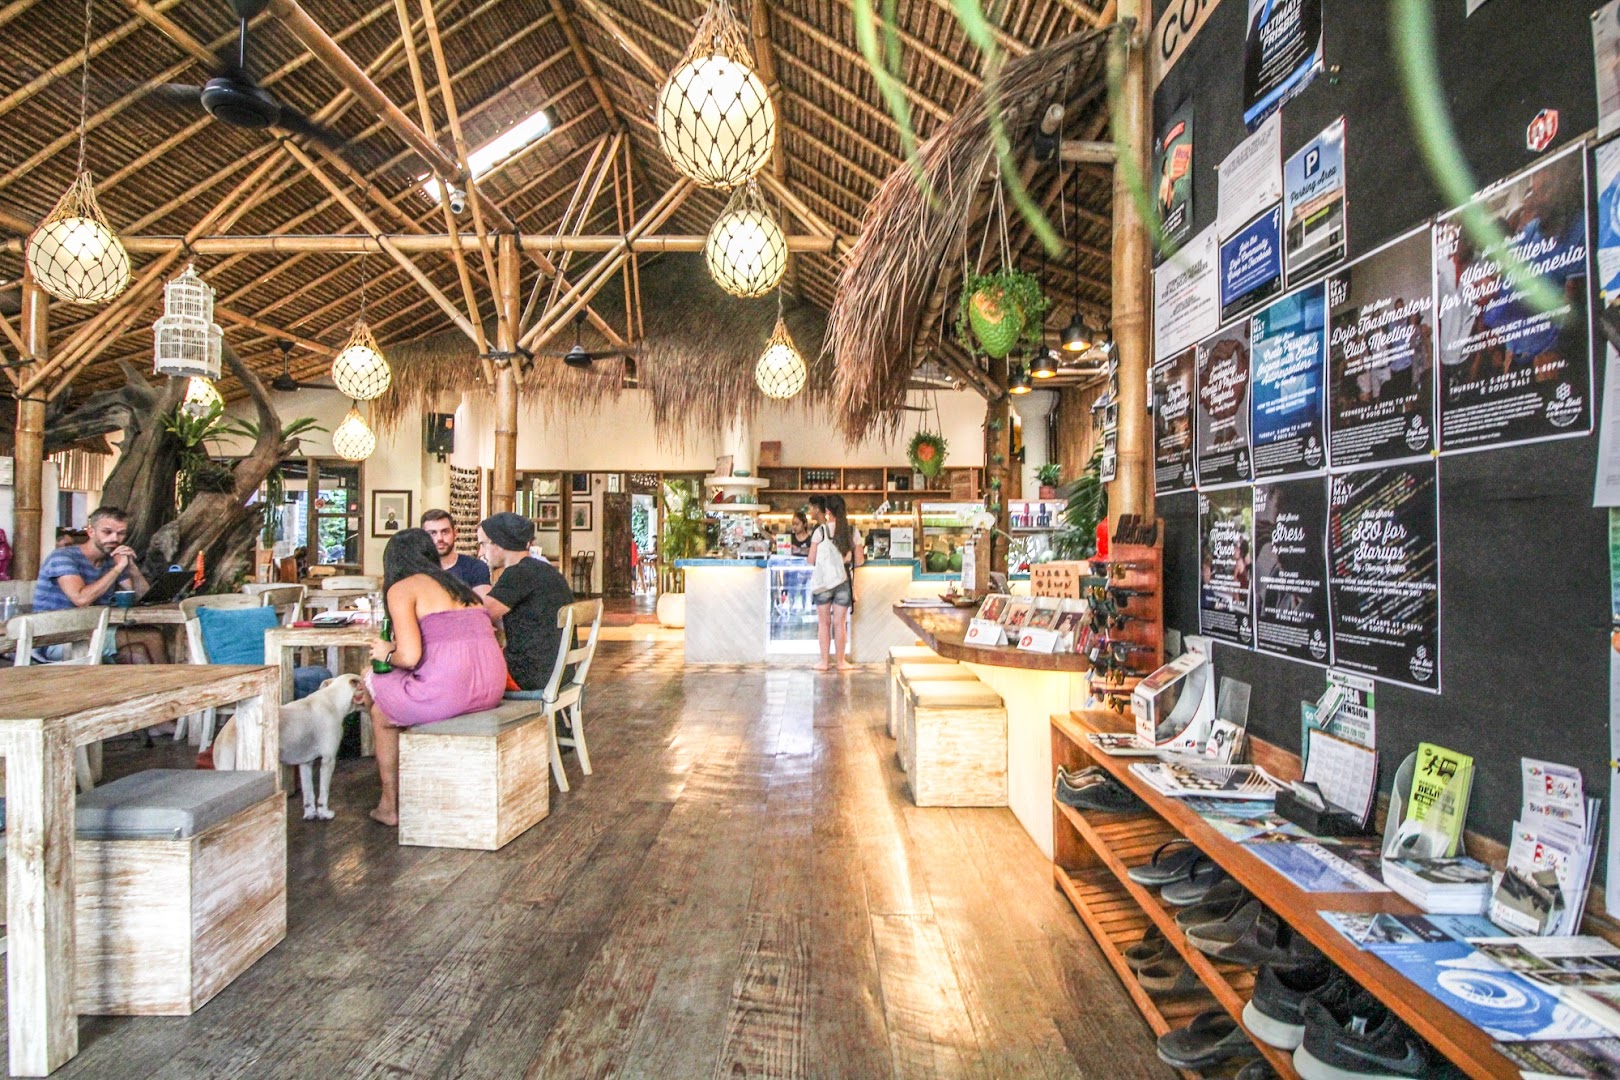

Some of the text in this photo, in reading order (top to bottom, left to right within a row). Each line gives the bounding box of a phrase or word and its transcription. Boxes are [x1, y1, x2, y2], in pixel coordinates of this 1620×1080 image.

[1262, 4, 1301, 49] FRISBEE
[1305, 151, 1318, 175] P
[1290, 166, 1336, 202] Parking Area
[1438, 240, 1458, 258] 2017
[1460, 257, 1502, 286] Water
[1330, 283, 1347, 297] MAY
[1439, 294, 1461, 317] for
[1462, 275, 1502, 305] Rural
[1502, 247, 1585, 288] Indonesia
[1330, 292, 1345, 306] 2017
[1252, 322, 1264, 332] MAY
[1330, 297, 1432, 345] Dojo Toastmasters
[1451, 331, 1490, 348] COMMUNITY
[1491, 320, 1522, 335] PROJECT
[1526, 305, 1570, 324] IMPROVING
[1253, 331, 1263, 342] 2017
[1343, 325, 1416, 359] Club Meeting
[1461, 322, 1550, 354] ACCESS TO CLEAN WATER
[1295, 342, 1319, 359] Email
[1546, 397, 1582, 410] Dojo Bali
[1256, 494, 1267, 502] MAY
[1332, 484, 1353, 495] MAY
[1332, 495, 1348, 504] 2017
[1361, 508, 1394, 519] Skill Share
[1271, 522, 1305, 544] Stress
[1351, 521, 1406, 544] SEO for
[1213, 542, 1234, 557] Lunch
[1353, 542, 1406, 567] Starups
[1397, 581, 1436, 589] OPTIMIZATION
